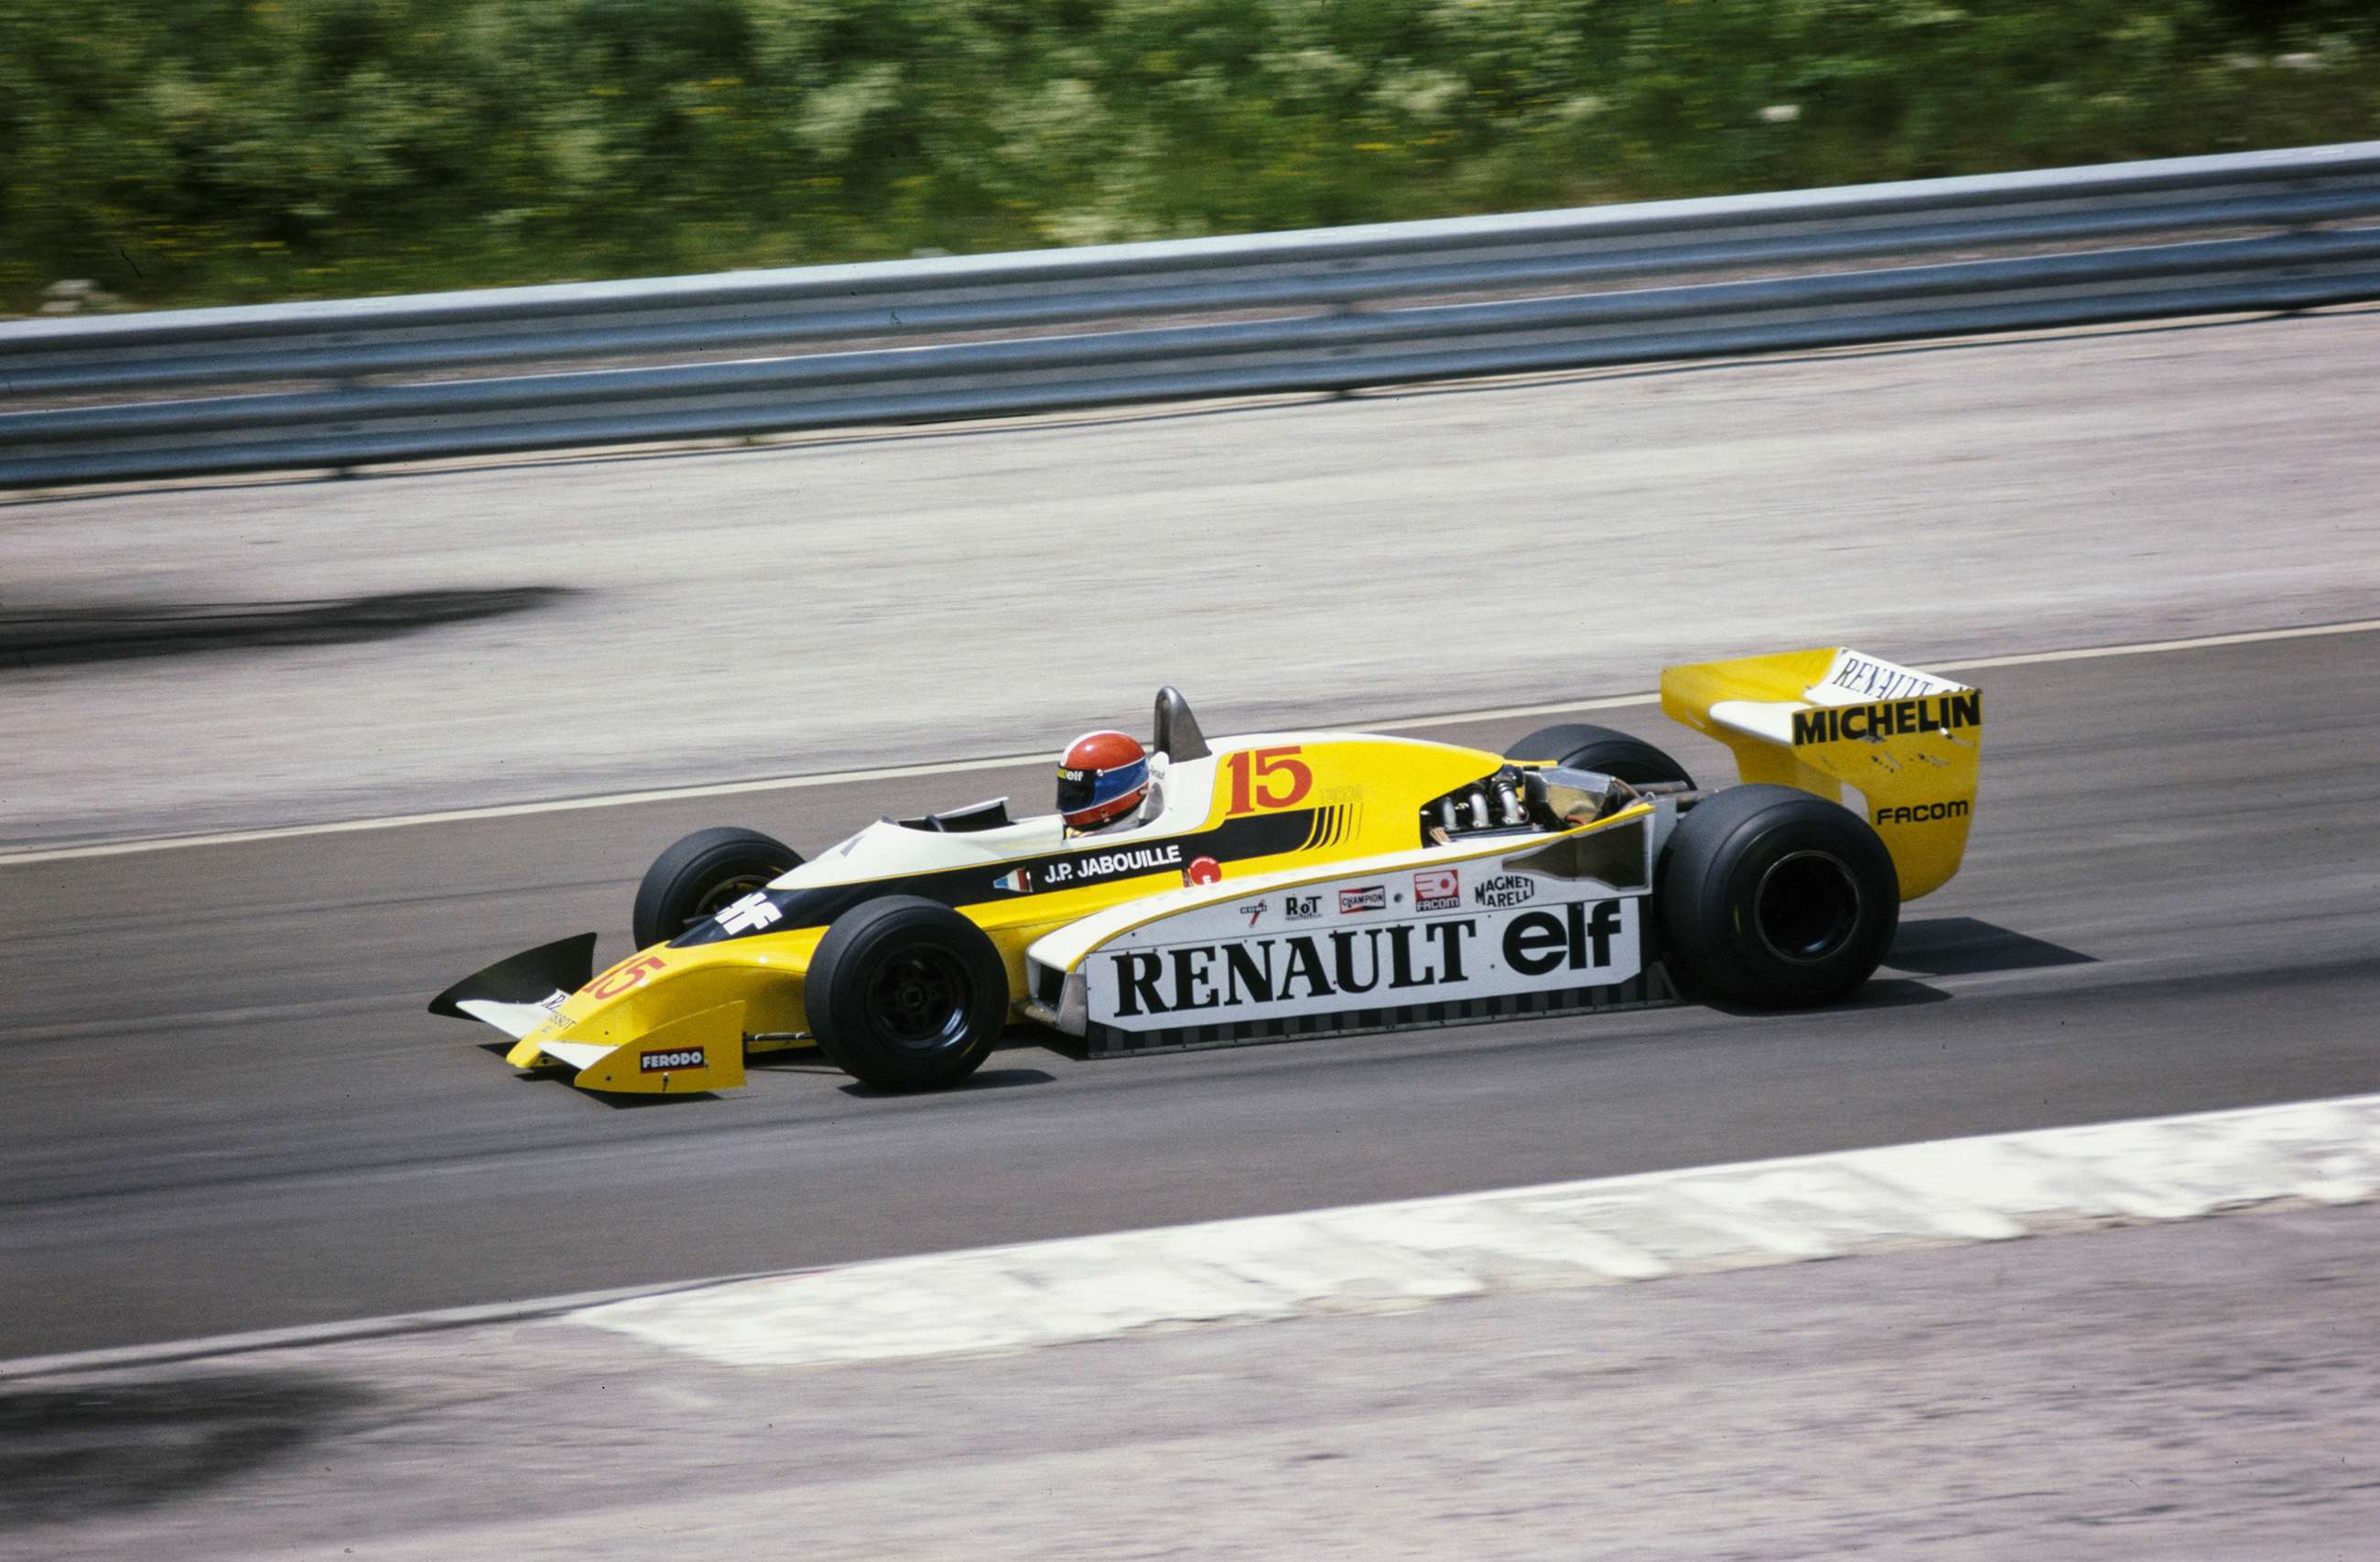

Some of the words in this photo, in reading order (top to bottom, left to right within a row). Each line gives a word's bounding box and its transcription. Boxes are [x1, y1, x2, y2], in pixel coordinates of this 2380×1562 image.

[1795, 694, 1981, 745] MICHELIN
[1066, 771, 1084, 782] elf
[1226, 746, 1313, 815] 15
[1877, 800, 1968, 825] FACOM
[1044, 862, 1073, 884] J.P.
[1077, 845, 1183, 878] JABOUILLE
[1475, 875, 1534, 897] MAGNETI
[1475, 888, 1534, 907] MARELLI
[1342, 893, 1384, 907] CHAMPION
[1417, 897, 1459, 911] FACOM
[1110, 919, 1477, 1018] RENAULT
[1502, 900, 1621, 976] elf
[582, 956, 666, 1000] 15
[642, 1051, 703, 1068] FERODO
